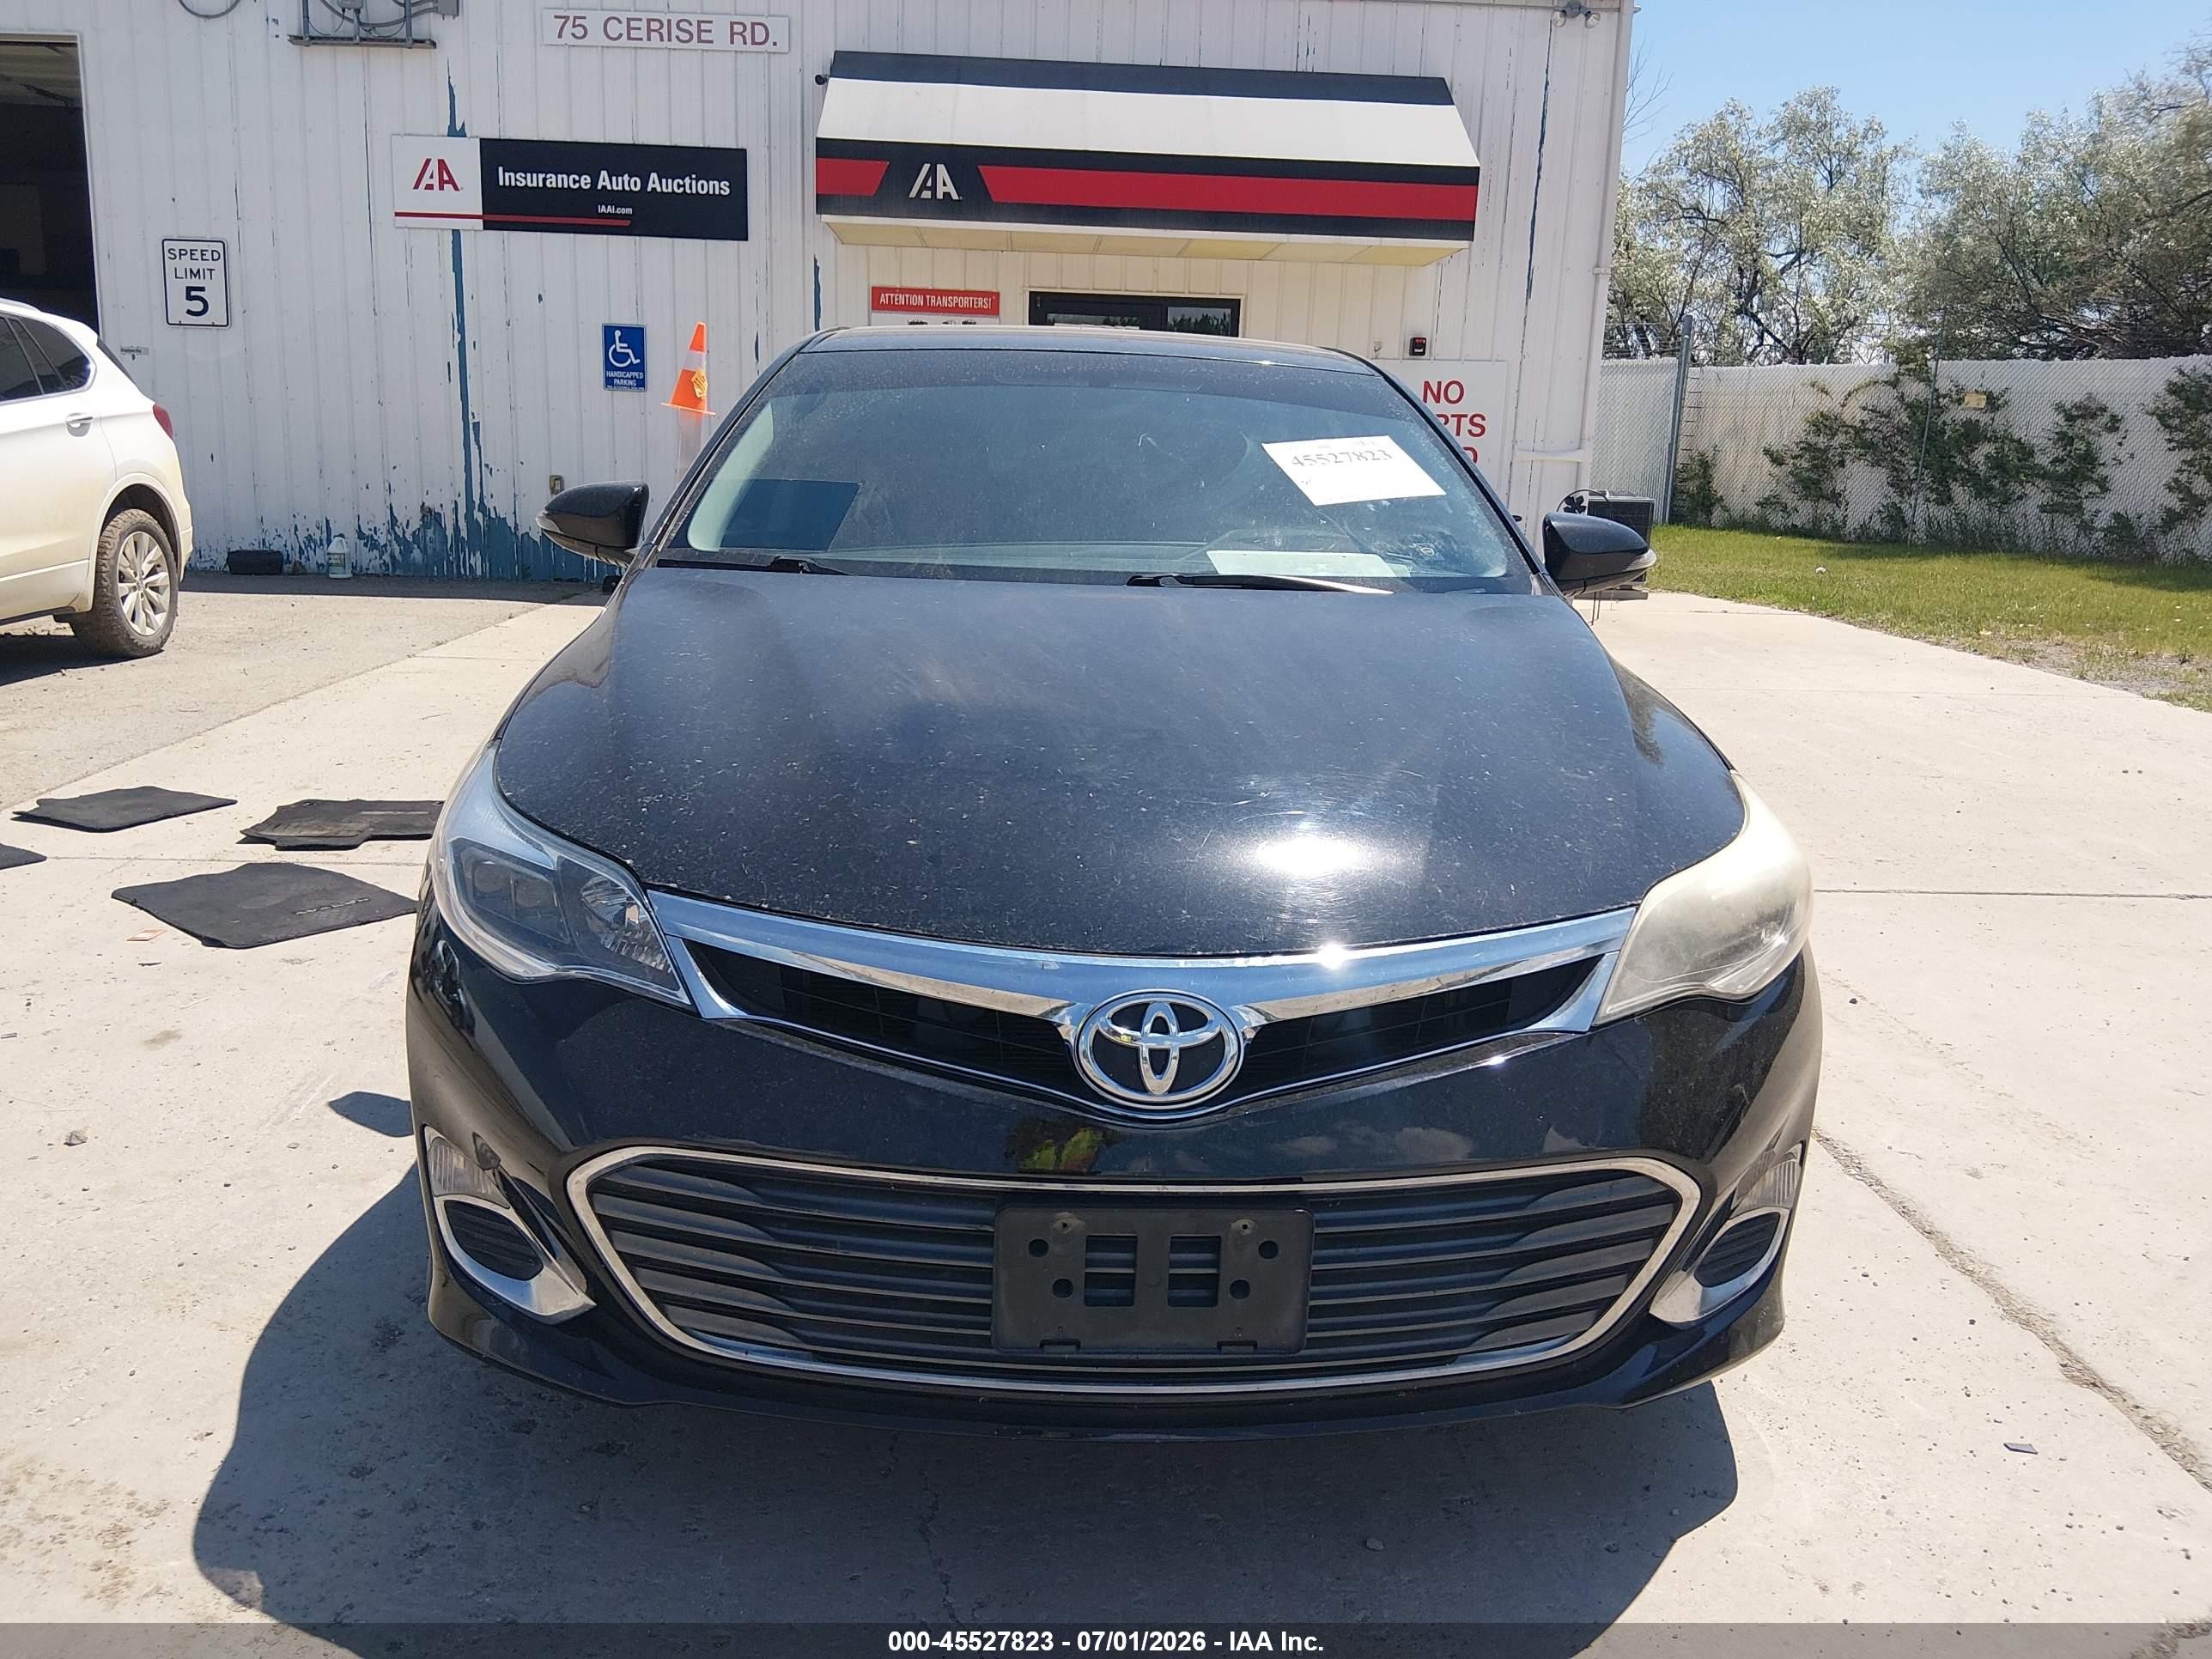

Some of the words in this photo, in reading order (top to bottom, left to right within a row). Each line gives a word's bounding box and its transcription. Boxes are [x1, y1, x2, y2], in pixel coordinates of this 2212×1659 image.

[553, 15, 588, 40] 75
[603, 16, 714, 44] CERISE
[729, 21, 777, 46] RD.
[498, 167, 591, 189] Insurance
[597, 170, 641, 191] Auto
[647, 173, 730, 195] Auctions
[167, 248, 221, 262] SPEED
[174, 267, 216, 280] LIMIT
[185, 285, 209, 317] 5
[879, 293, 923, 307] ATTENTION
[926, 295, 992, 309] TRANSPORTERS!
[606, 370, 644, 379] HANDICAPPED
[1422, 380, 1465, 404] NO
[1291, 449, 1393, 467] 45527823
